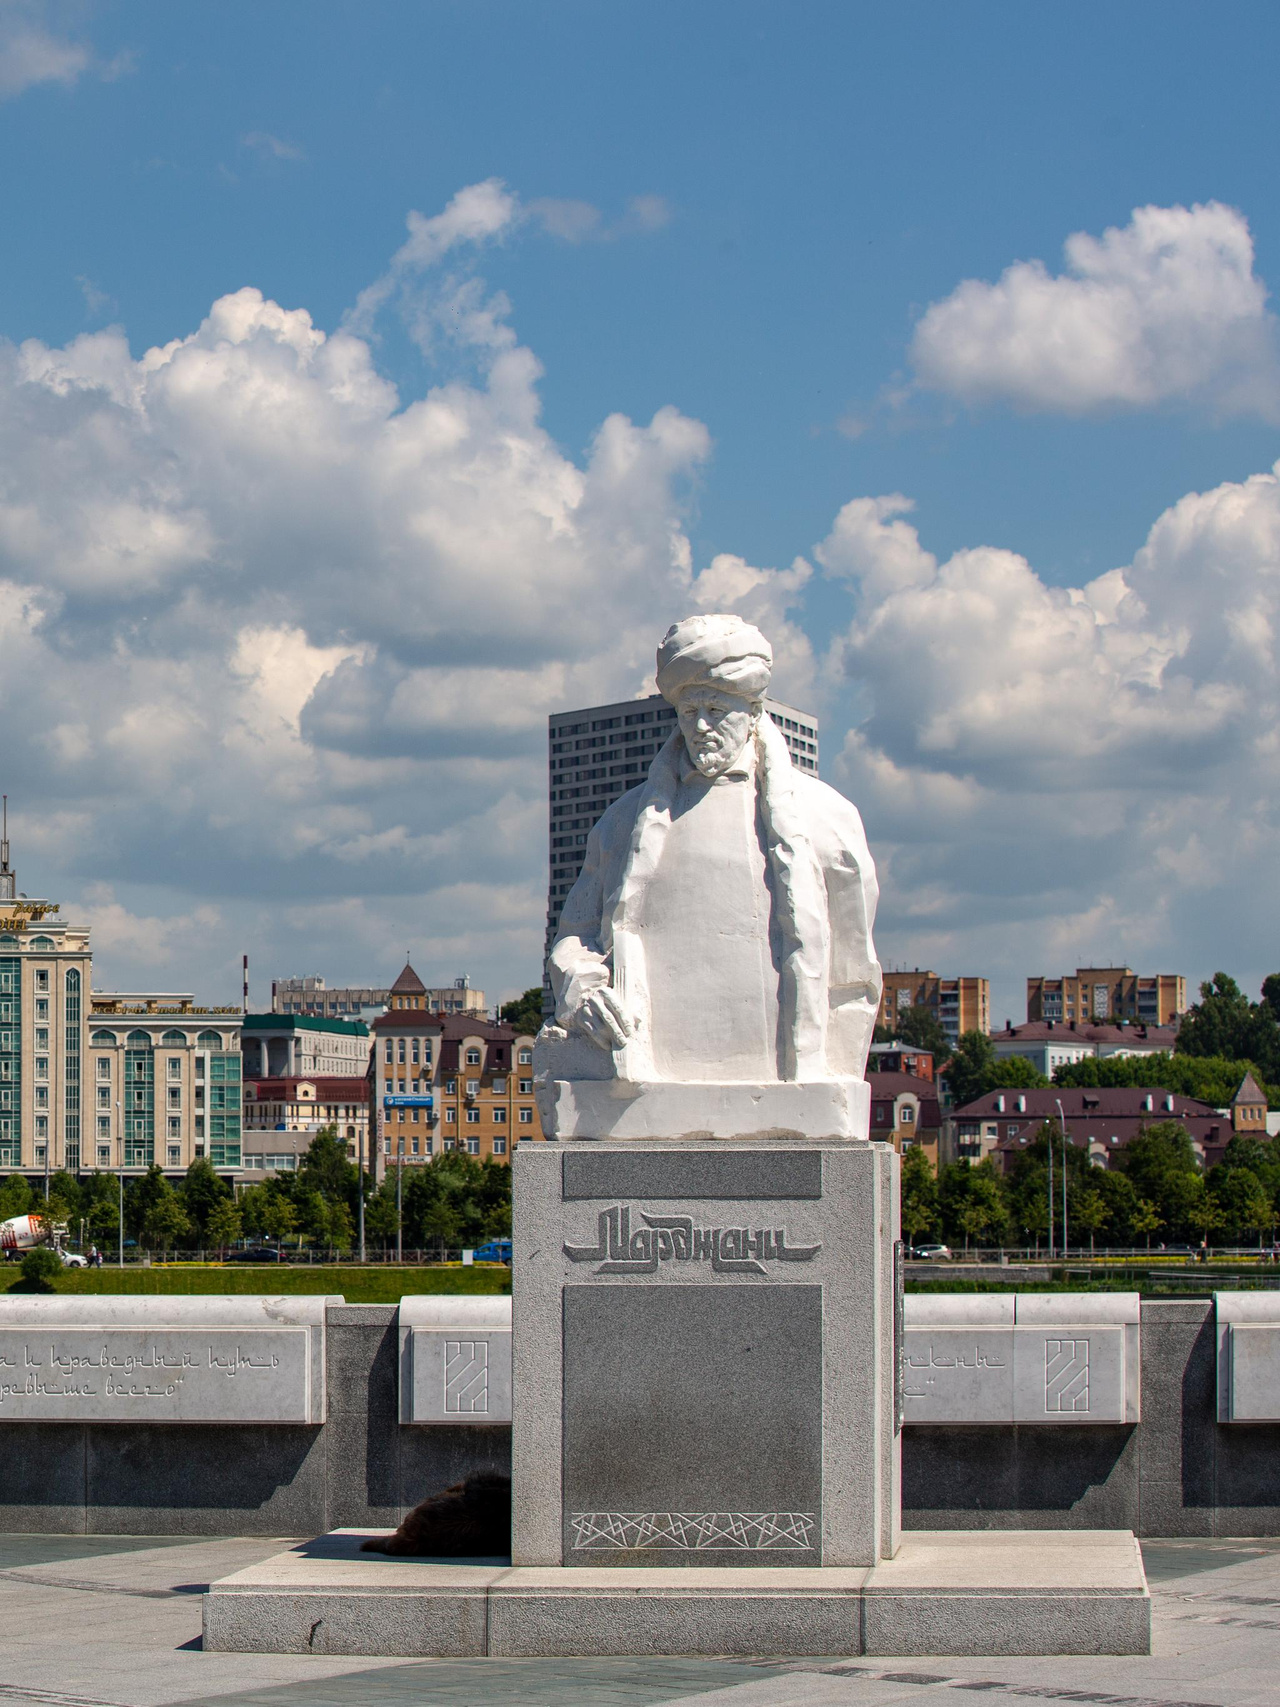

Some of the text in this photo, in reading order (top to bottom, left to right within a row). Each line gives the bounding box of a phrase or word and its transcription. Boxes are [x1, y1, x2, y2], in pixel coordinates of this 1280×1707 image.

[10, 900, 60, 918] Palace
[562, 1204, 823, 1276] Марджани
[24, 1344, 42, 1368] и
[50, 1343, 200, 1377] праведный
[208, 1344, 280, 1377] путь
